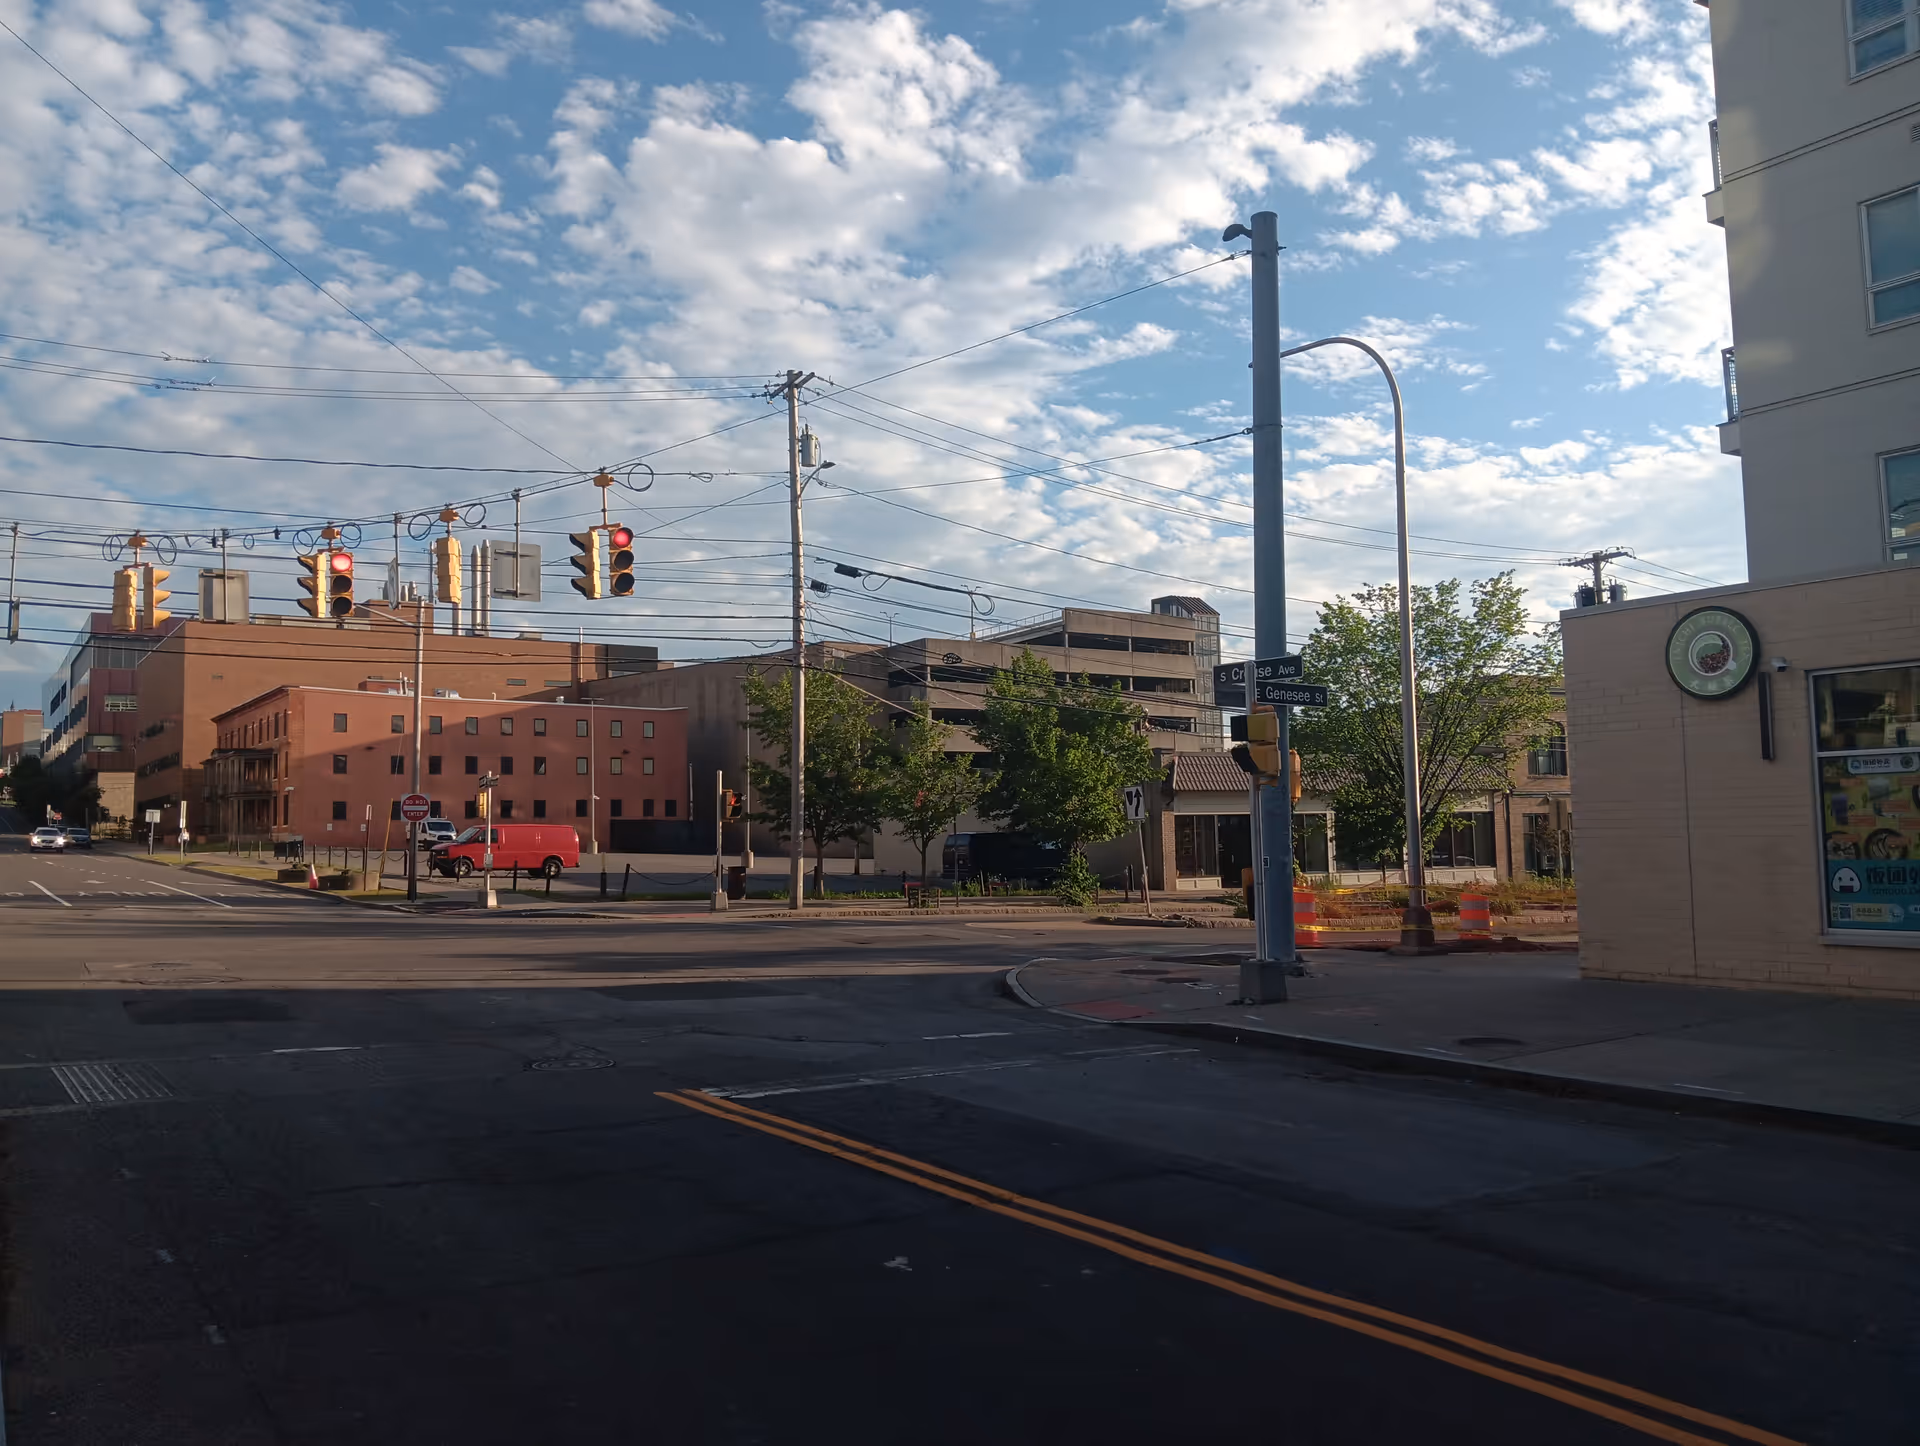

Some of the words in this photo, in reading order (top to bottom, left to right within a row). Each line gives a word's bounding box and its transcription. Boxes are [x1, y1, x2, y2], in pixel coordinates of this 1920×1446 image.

[1220, 672, 1227, 682] S
[1231, 666, 1272, 680] Crse
[1278, 665, 1296, 676] Ave
[1265, 686, 1311, 702] Genesee
[1315, 693, 1324, 703] St
